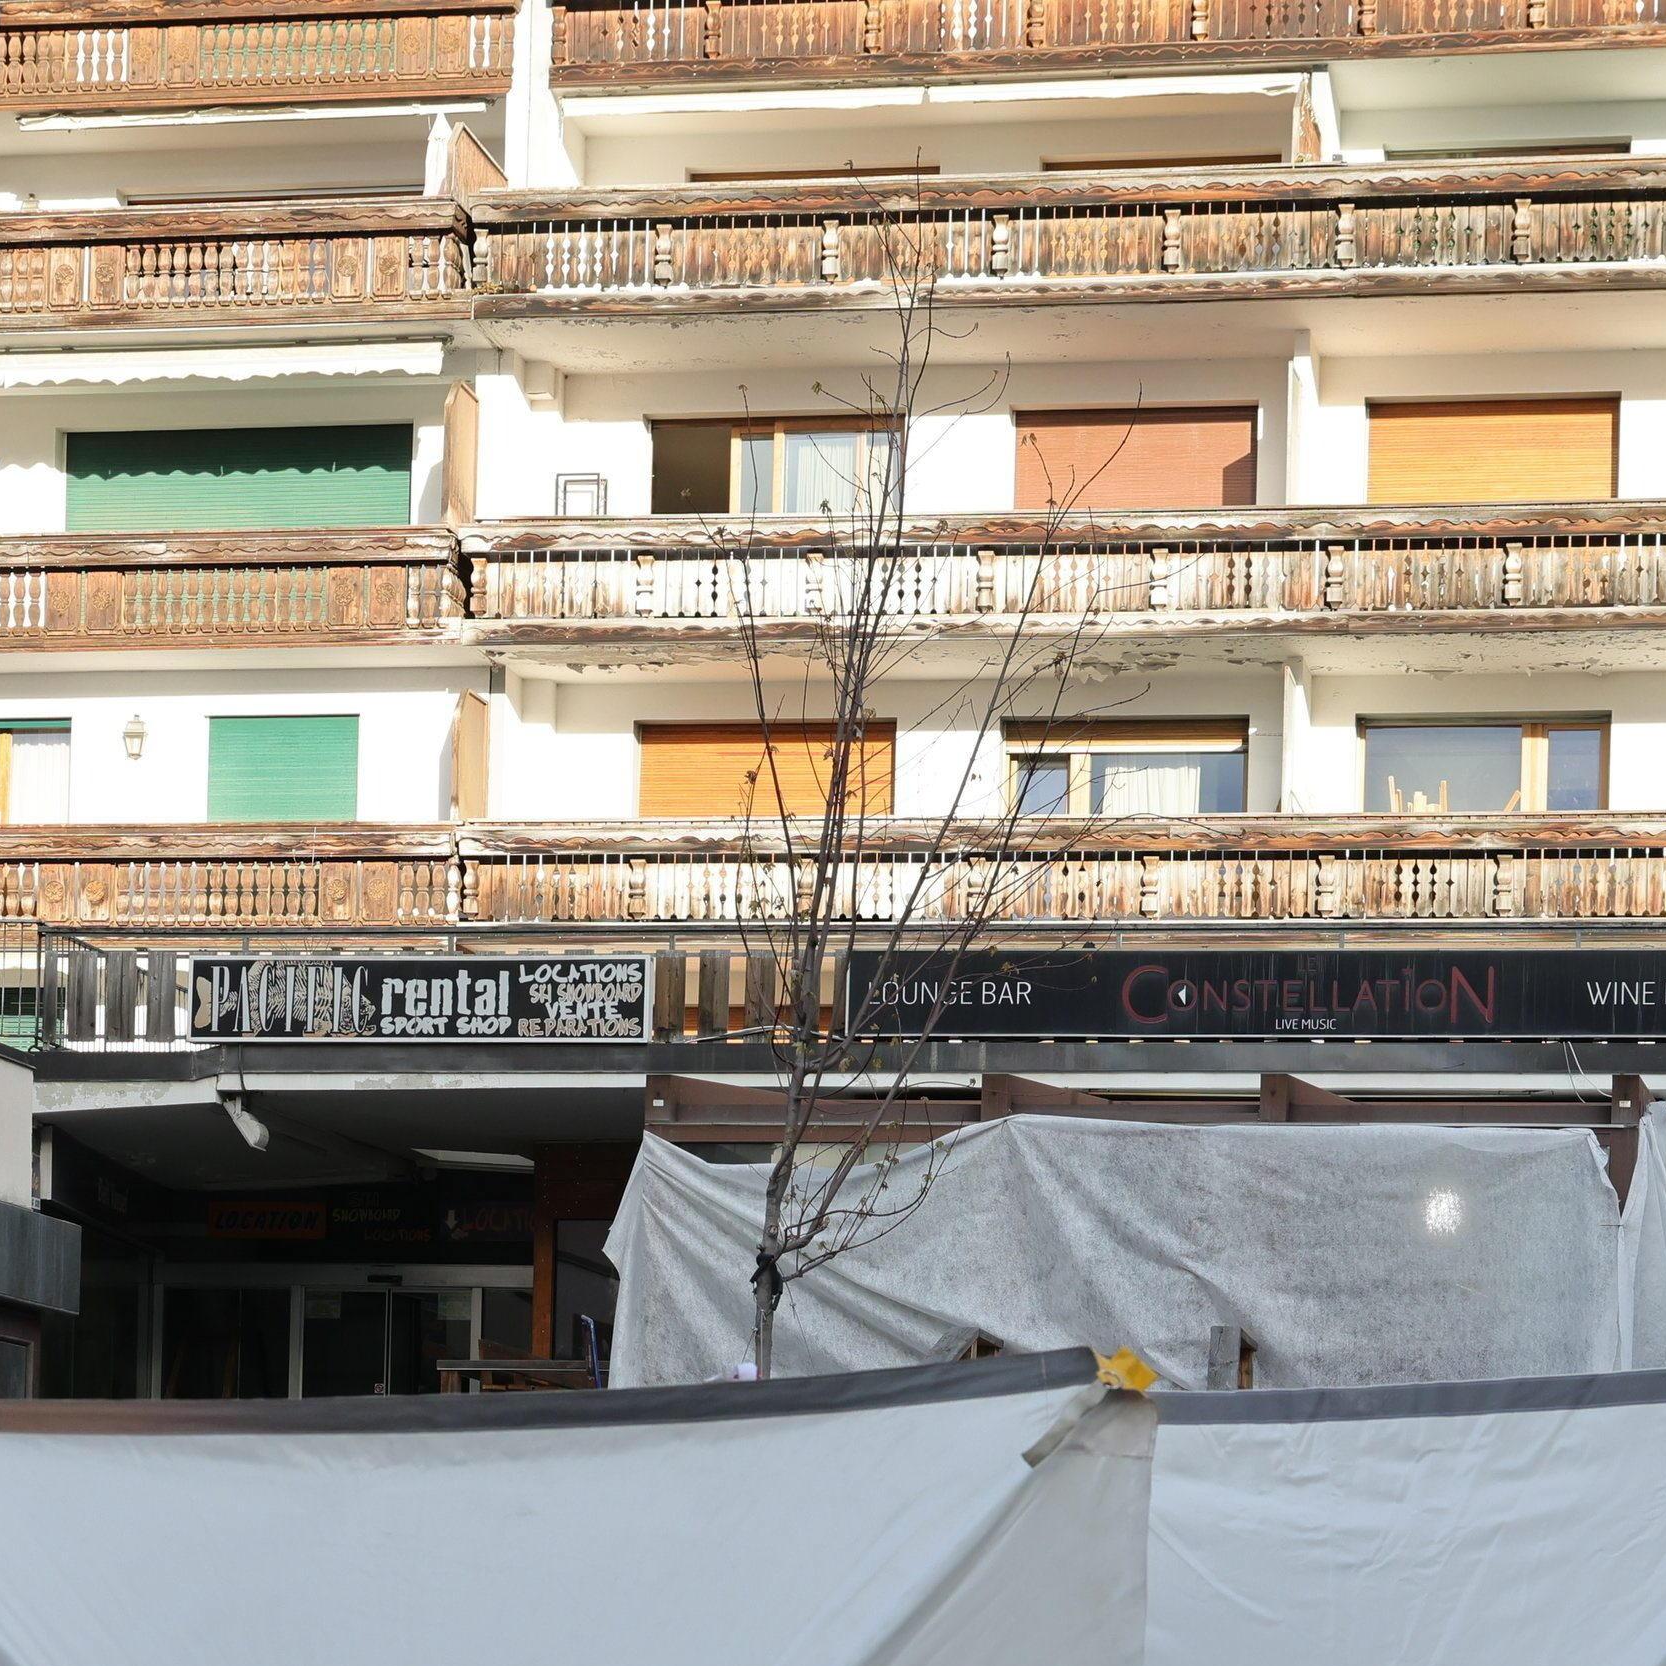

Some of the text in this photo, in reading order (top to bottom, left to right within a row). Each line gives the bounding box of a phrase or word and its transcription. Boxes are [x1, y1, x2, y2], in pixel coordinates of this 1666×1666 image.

[518, 963, 643, 983] LOCATIONS
[210, 965, 369, 1033] PACIFIC
[381, 969, 510, 1016] rental
[529, 983, 643, 1003] SKI SNOWBOARD
[869, 981, 1032, 1005] LOUNGE BAR
[1586, 981, 1656, 1005] WINE
[545, 1001, 622, 1020] VENTE
[380, 1016, 512, 1035] SPORT SHOP
[518, 1018, 642, 1037] REPARATIONS
[1275, 1018, 1337, 1030] LIVE MUSIC
[215, 1208, 319, 1231] LOCATION
